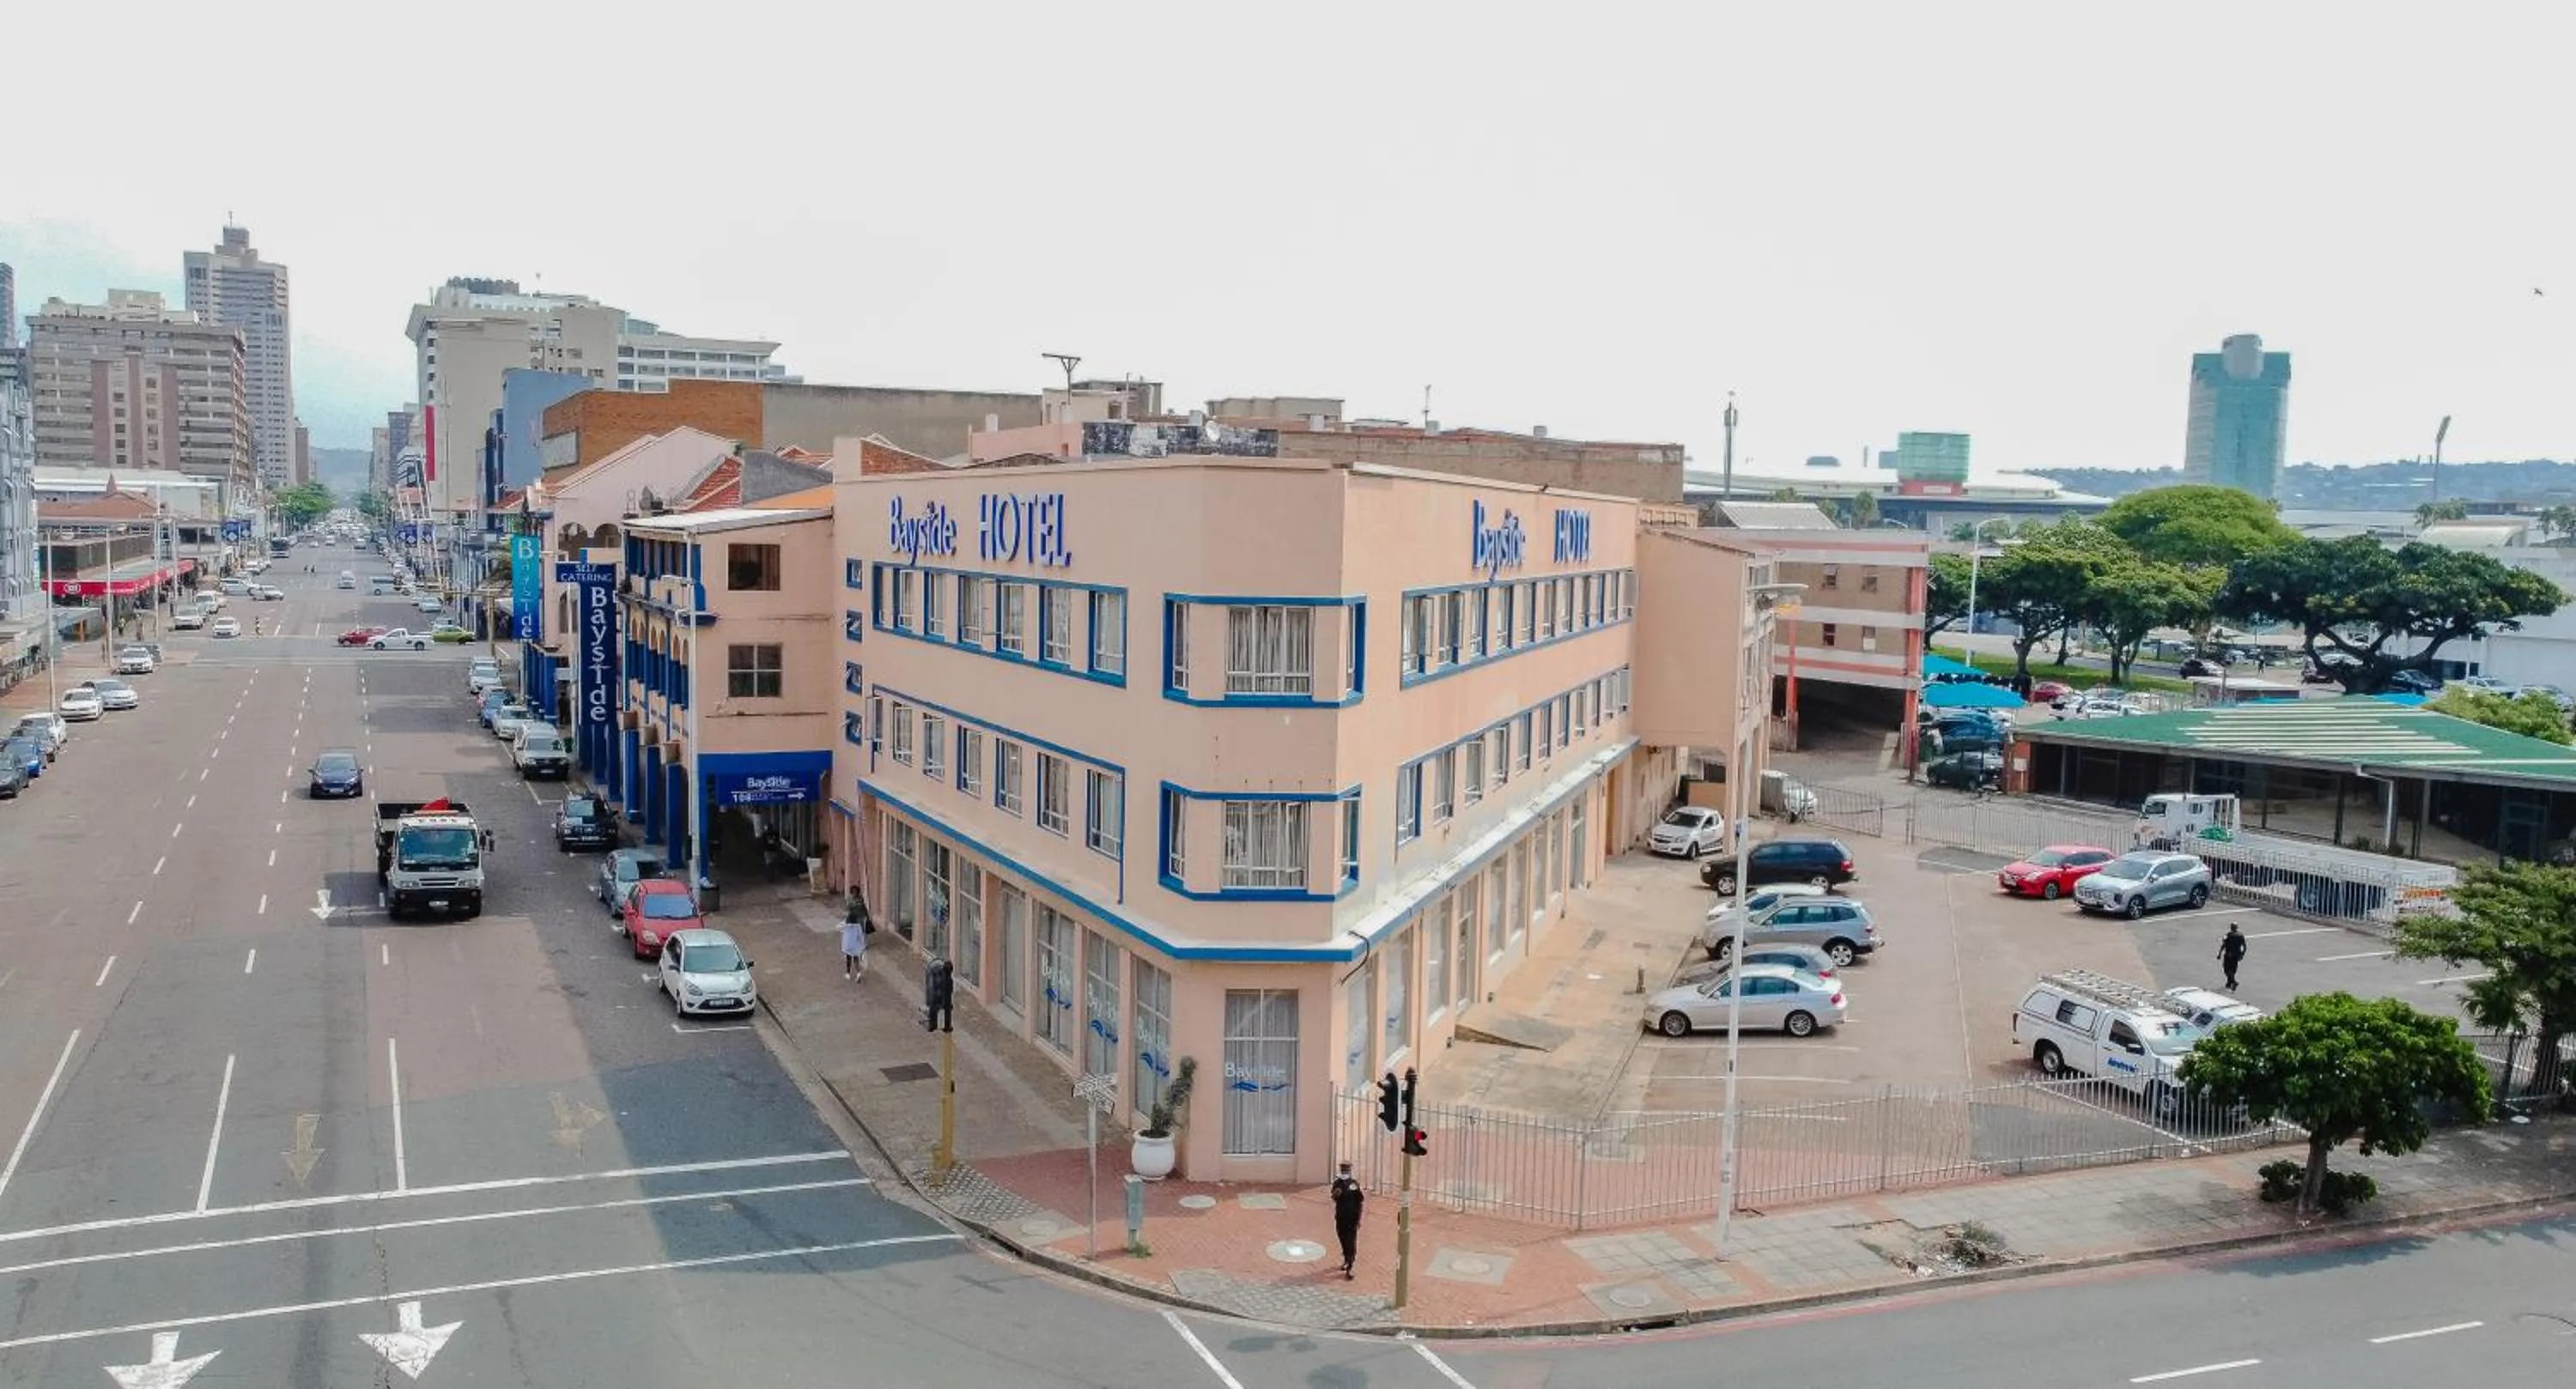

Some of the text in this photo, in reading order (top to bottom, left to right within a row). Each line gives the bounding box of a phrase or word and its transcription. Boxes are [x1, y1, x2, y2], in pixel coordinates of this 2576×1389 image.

[890, 493, 1072, 567] Bayside HOTEL
[1554, 509, 1592, 563] HOTEL
[560, 573, 612, 583] CATERING
[1224, 1062, 1287, 1079] Bayide
